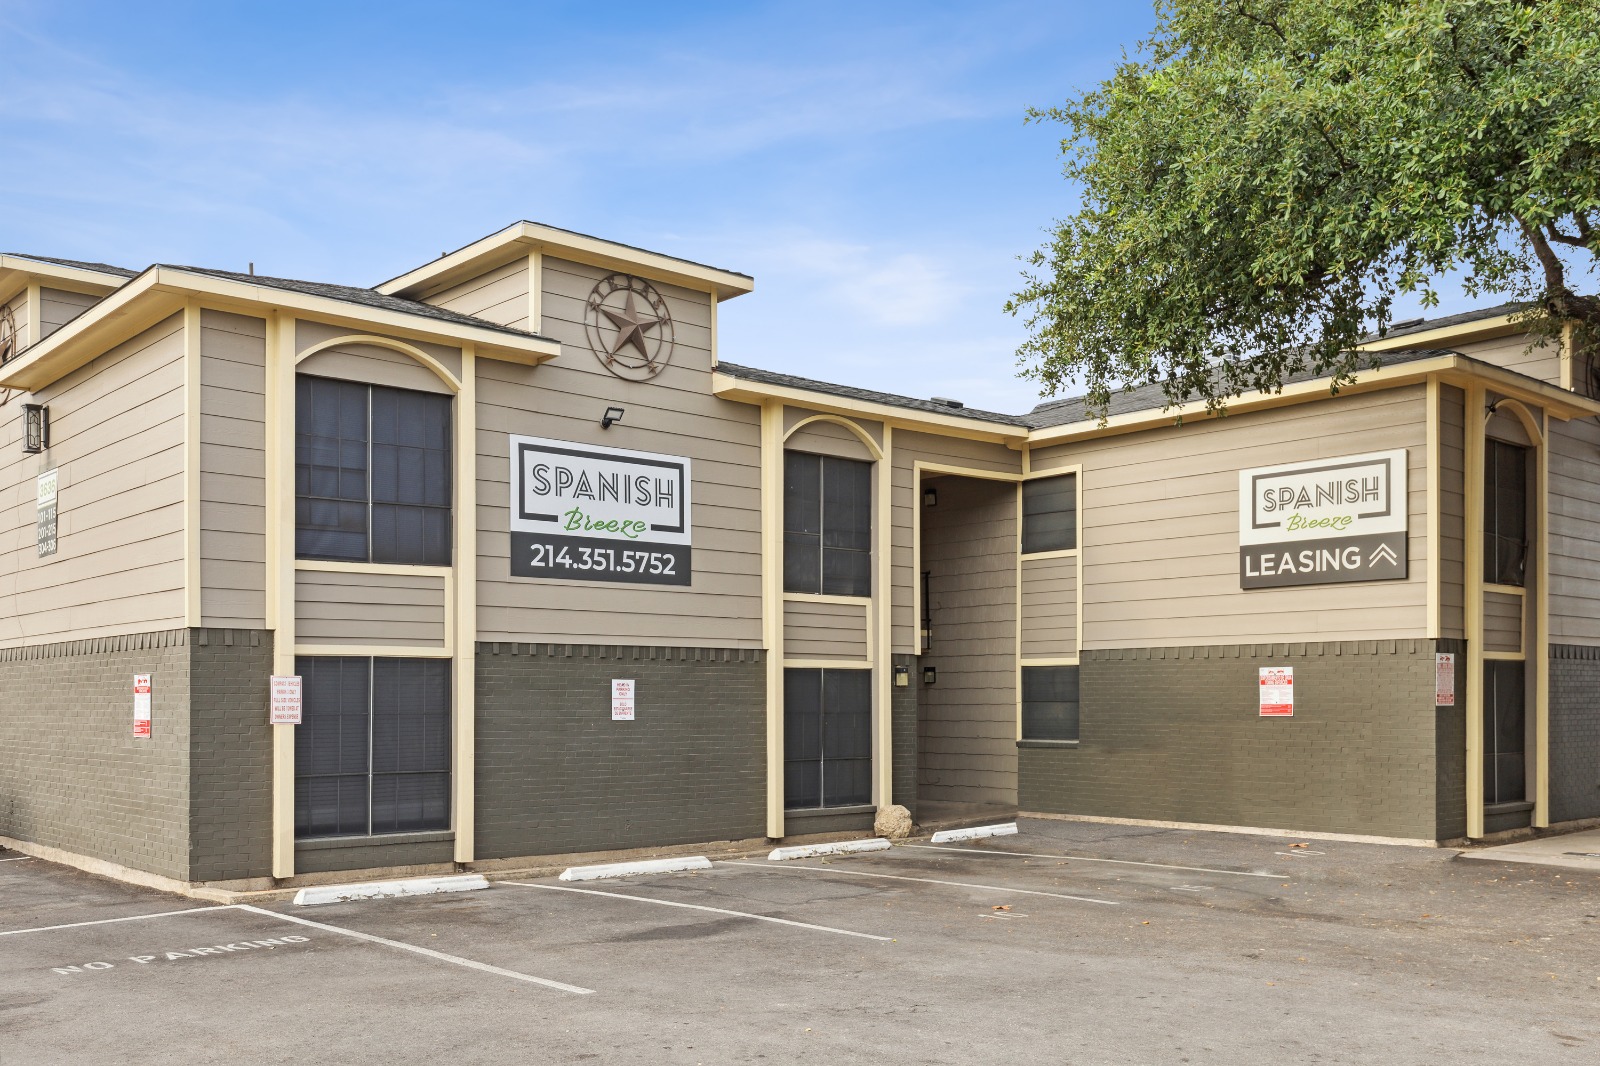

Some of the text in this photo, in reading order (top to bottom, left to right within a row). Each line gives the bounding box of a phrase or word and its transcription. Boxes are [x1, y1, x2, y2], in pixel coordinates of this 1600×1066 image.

[532, 463, 674, 509] SPANISH
[1262, 476, 1379, 512] SPANISH
[563, 506, 647, 539] Breeze
[1286, 512, 1353, 532] Breeze
[530, 543, 676, 576] 214.351.5752
[1245, 546, 1361, 577] LEASING
[50, 935, 311, 975] NO PARKING
